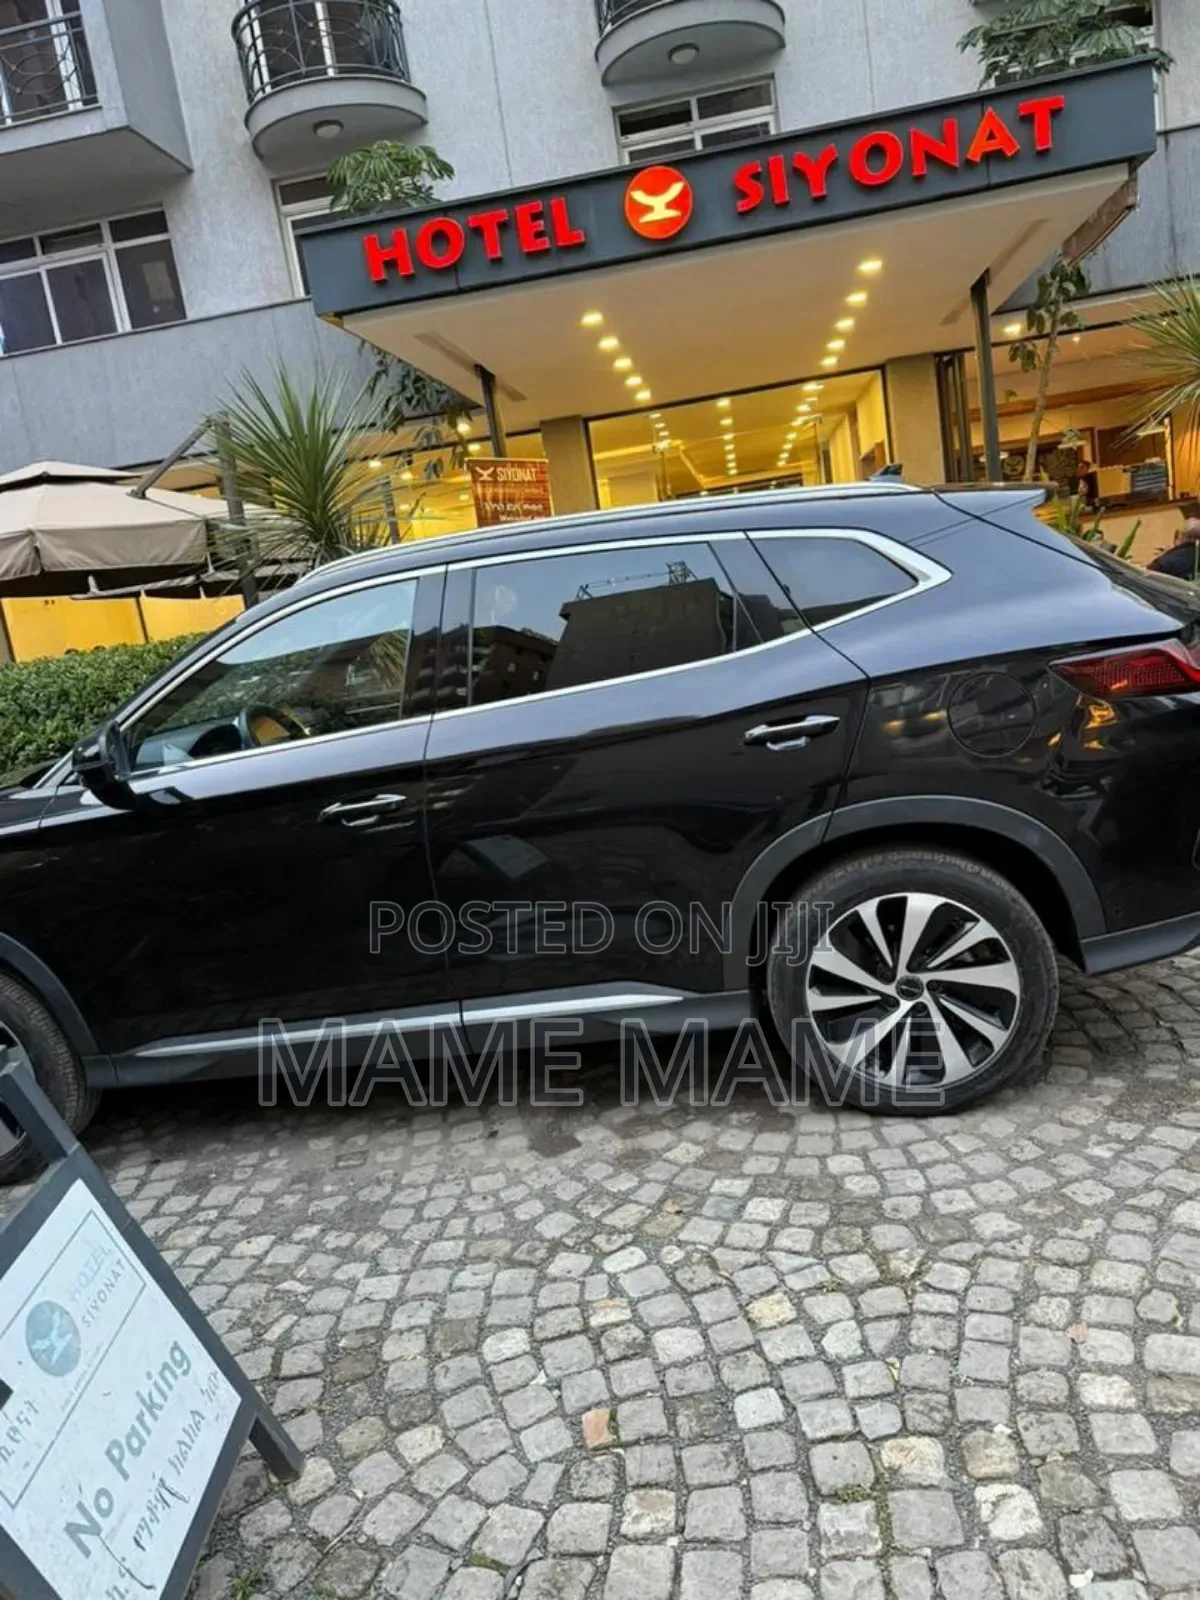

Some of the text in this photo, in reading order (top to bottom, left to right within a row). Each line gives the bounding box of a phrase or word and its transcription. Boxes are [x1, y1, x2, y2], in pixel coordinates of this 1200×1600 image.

[363, 94, 1066, 284] HOTEL SIYONAT
[496, 465, 537, 482] SIYONAT
[70, 1243, 113, 1303] HOTEL
[81, 1258, 127, 1329] SIYONAT
[63, 1487, 114, 1560] No
[104, 1341, 191, 1482] Parking
